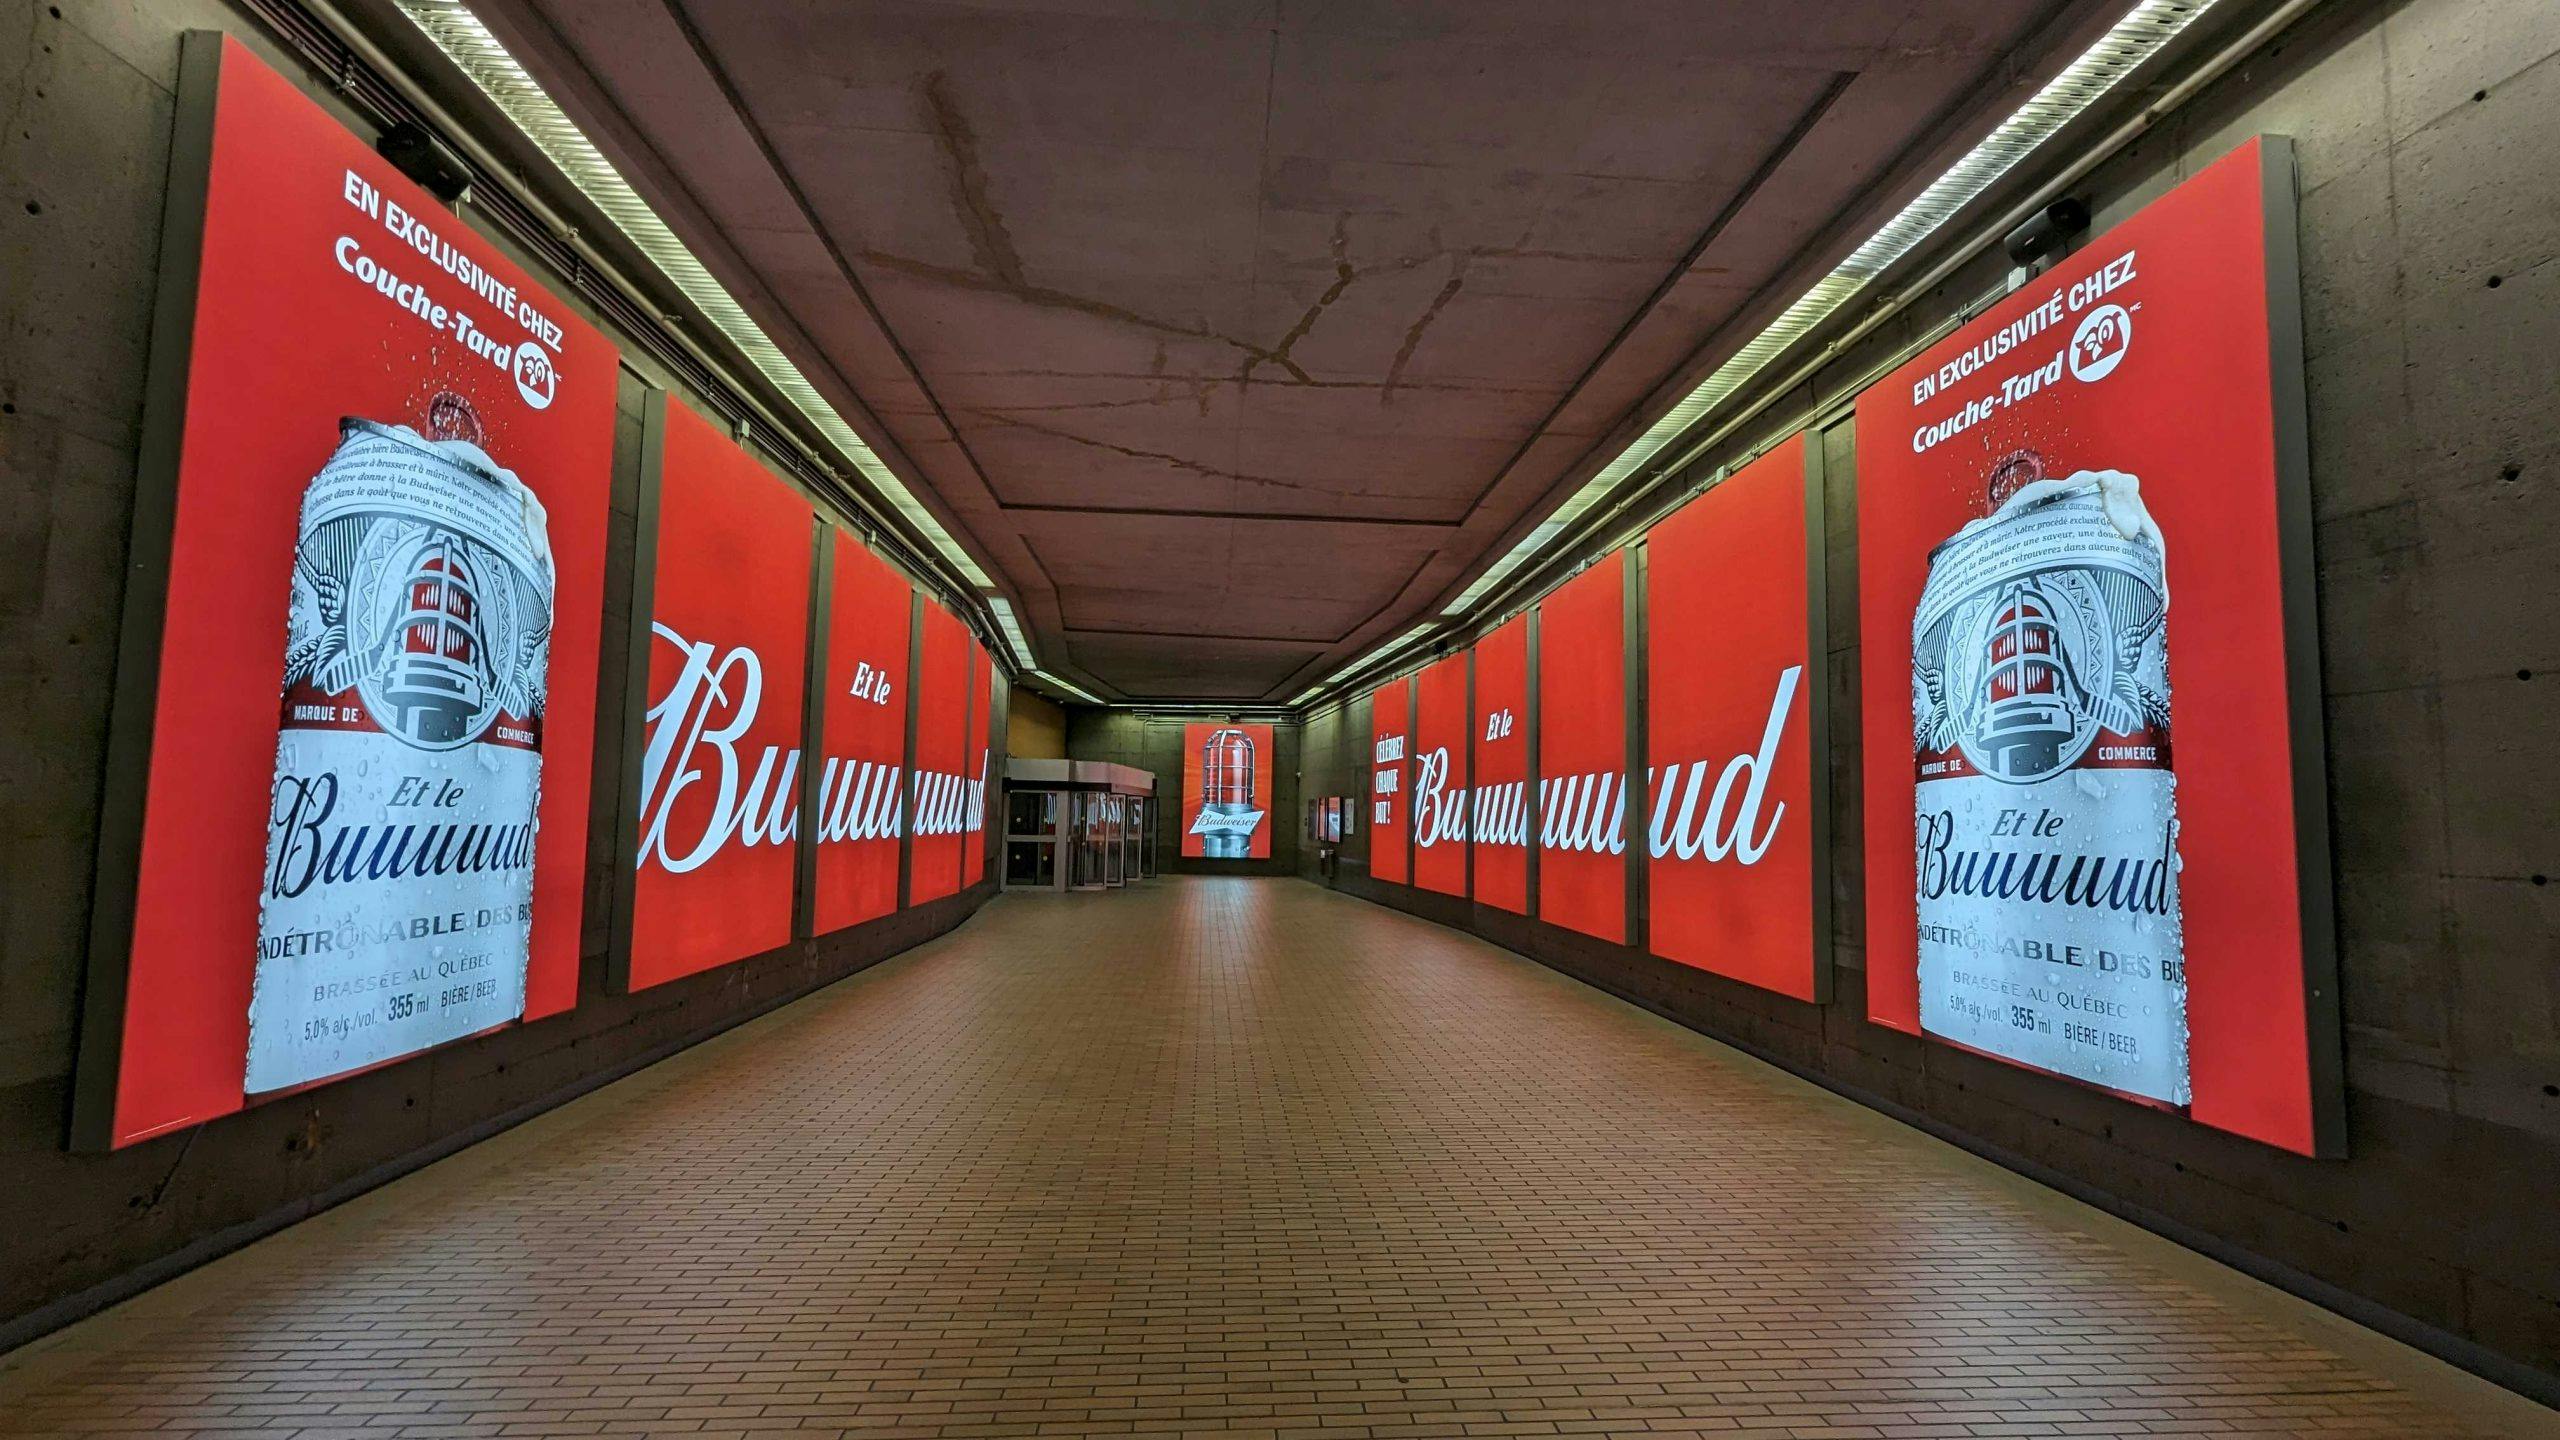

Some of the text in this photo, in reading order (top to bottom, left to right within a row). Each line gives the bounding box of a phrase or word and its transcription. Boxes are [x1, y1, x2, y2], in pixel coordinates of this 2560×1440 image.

[344, 169, 563, 352] EN EXCLUSIVITÉ CHEZ
[335, 236, 512, 371] Couche-Tard
[1913, 250, 2136, 406] EN EXCLUSIVITÉ CHEZ
[1913, 350, 2064, 453] Couche-Tard
[376, 459, 407, 470] brasser
[358, 472, 386, 481] donne
[397, 475, 407, 485] la
[409, 477, 457, 500] Budweiser
[459, 496, 474, 509] une
[333, 489, 355, 499] dans
[357, 487, 365, 496] le
[390, 491, 407, 500] que
[409, 494, 430, 505] vous
[432, 501, 444, 510] ne
[445, 504, 491, 533] retrouverez
[2037, 516, 2068, 530] procédé
[2023, 537, 2040, 547] une
[2042, 532, 2076, 542] saveur,
[2078, 530, 2095, 538] une
[1979, 564, 1998, 577] vous
[1999, 559, 2010, 568] ne
[2011, 546, 2062, 564] retrouverez
[2064, 543, 2086, 552] dans
[2088, 544, 2120, 553] aucune
[850, 661, 891, 706] Et le
[294, 706, 358, 721] MARQUE DE
[1486, 708, 1513, 742] Et le
[497, 726, 534, 744] COMMERCE
[1921, 759, 1961, 775] MARQUE DE
[2098, 746, 2156, 761] COMMERCE
[386, 776, 464, 808] Et le
[1375, 769, 1398, 797] CHAQUE
[1196, 814, 1257, 826] Budweiser
[1990, 808, 2064, 837] Et le
[477, 907, 512, 929] DES
[313, 952, 494, 1001] BRASSÉE AU QUÉBEC
[2099, 950, 2151, 979] DES
[388, 993, 414, 1022] 355
[416, 995, 430, 1014] ml
[1953, 970, 2128, 1019] BRASSÉE AU QUÉBEC
[2011, 1005, 2034, 1031] 355
[2038, 1017, 2051, 1034] ml
